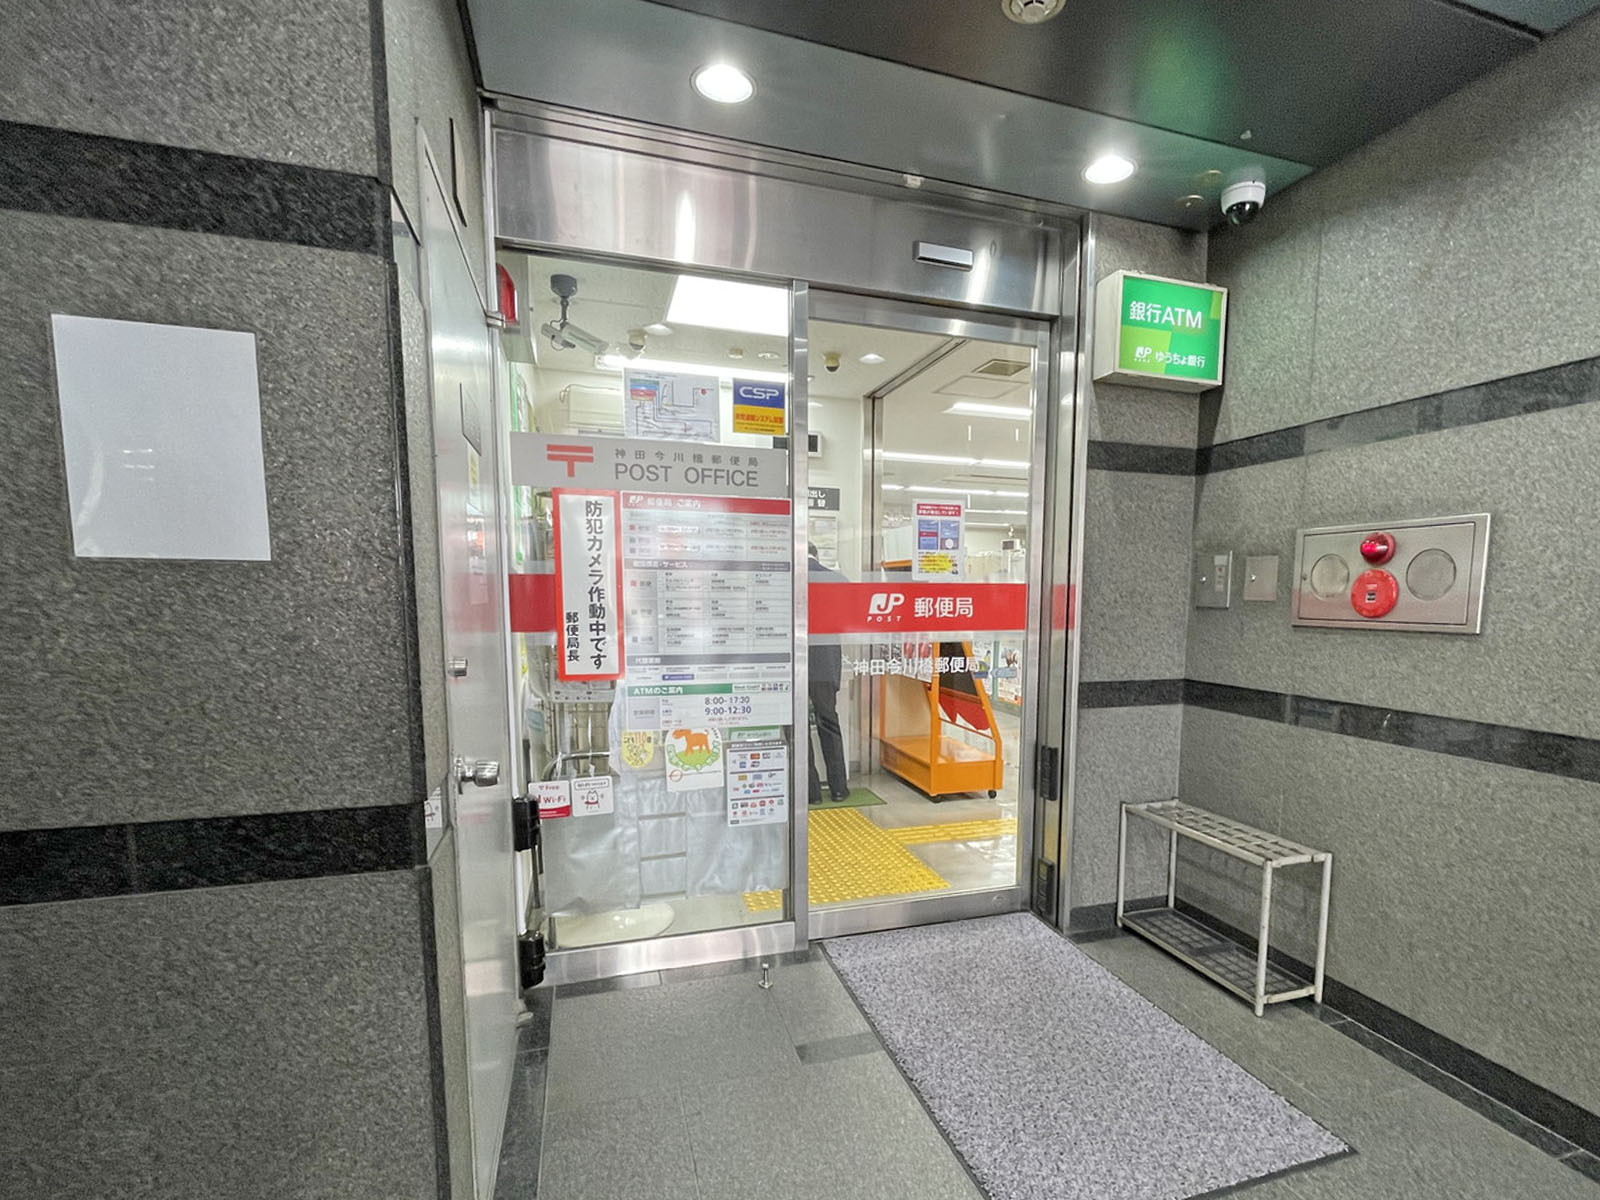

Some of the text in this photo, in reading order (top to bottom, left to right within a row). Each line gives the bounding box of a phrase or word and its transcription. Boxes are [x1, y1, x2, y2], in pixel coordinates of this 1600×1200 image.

[1129, 301, 1202, 329] 銀行ATM
[1155, 351, 1206, 368] ゆうちょ銀行
[739, 386, 780, 400] CSP
[615, 463, 759, 487] POST OFFICE
[808, 490, 826, 499] 出し
[585, 500, 607, 670] 防犯カメラ作動中です
[914, 597, 974, 618] 郵便局
[565, 612, 580, 662] 郵便局長
[854, 657, 980, 676] 神田今川橋郵便局
[633, 686, 684, 695] ATMのご案内
[544, 795, 567, 804] Wi-Fi
